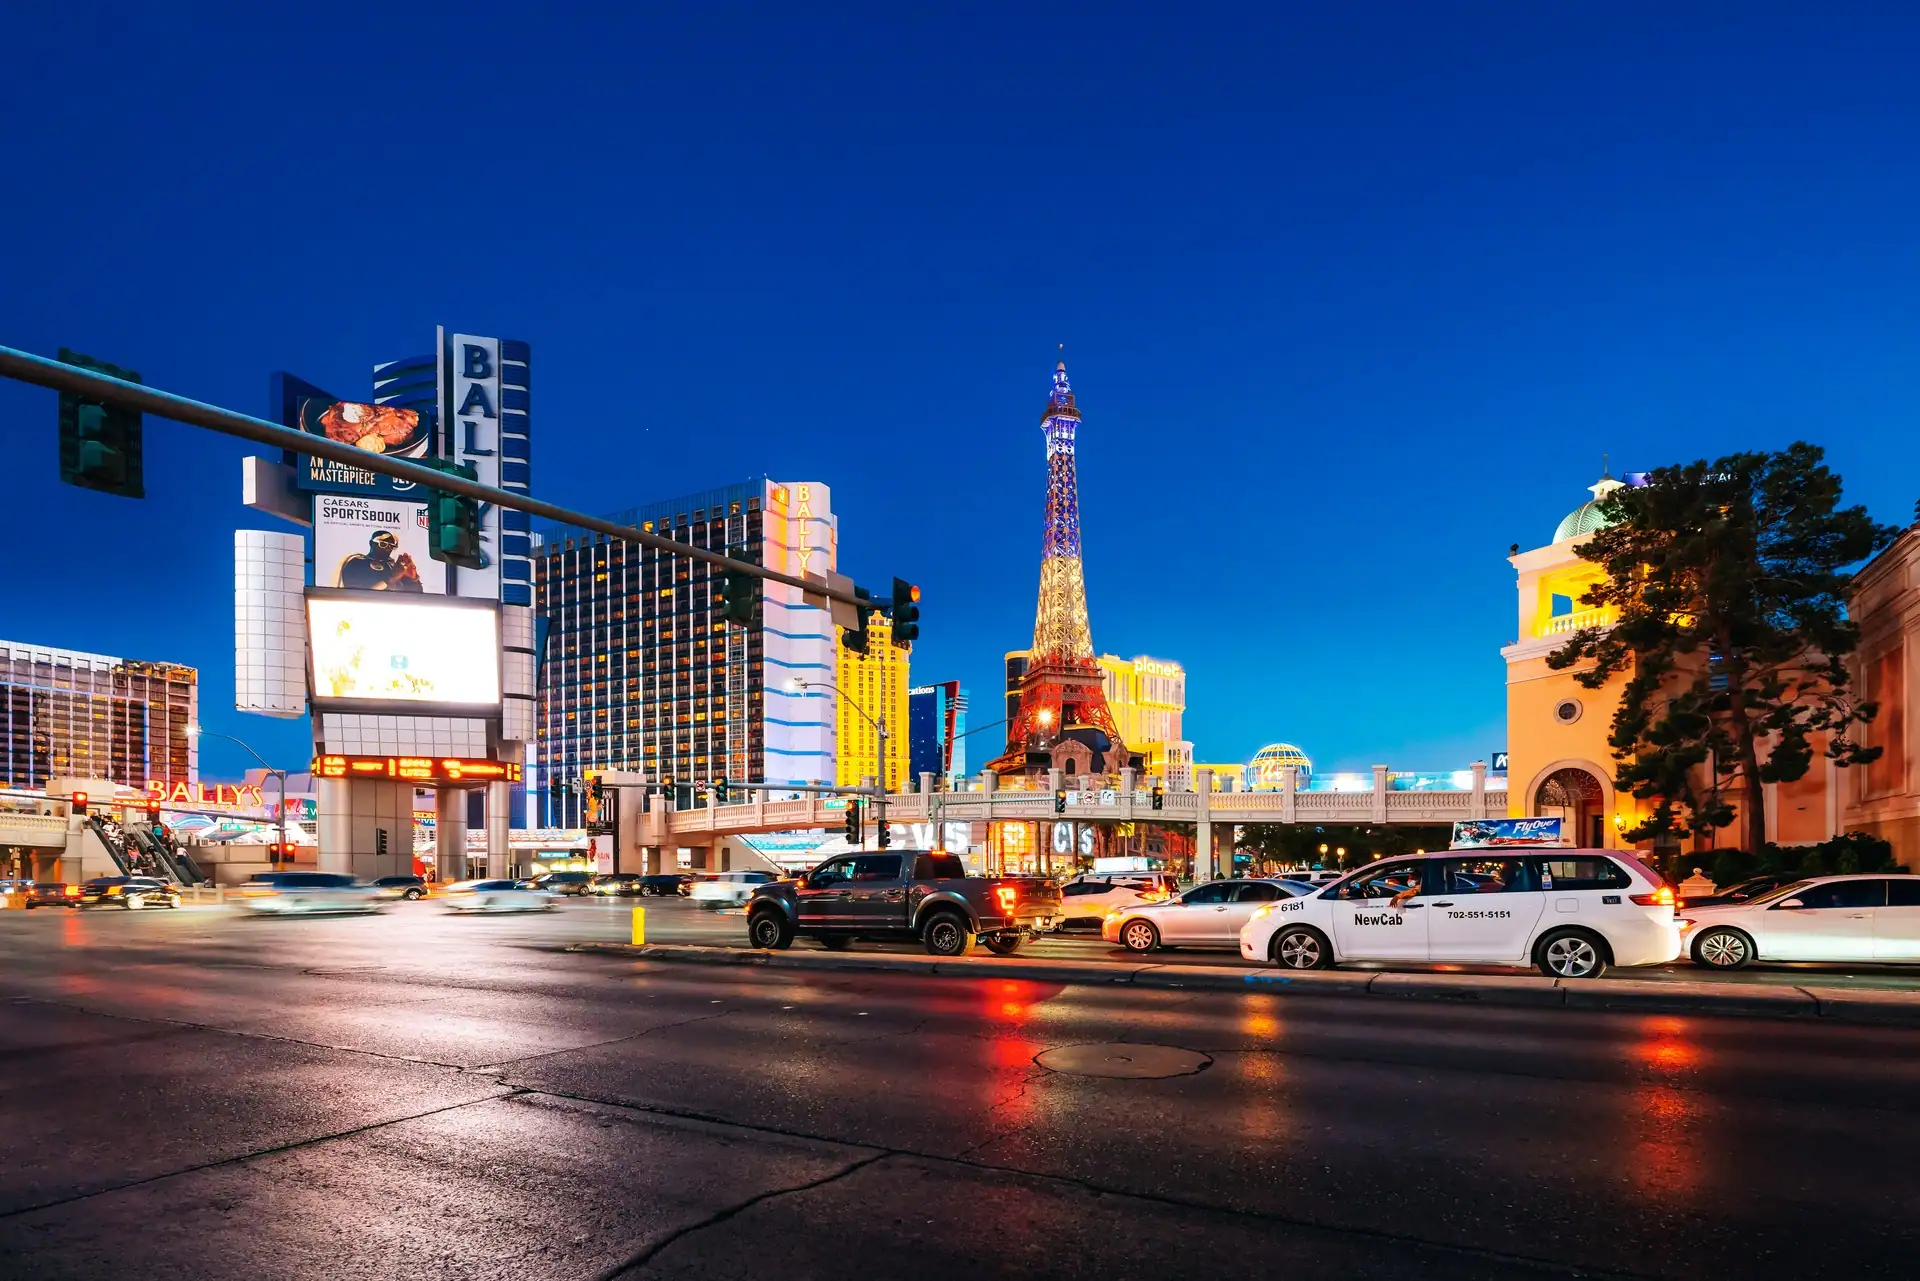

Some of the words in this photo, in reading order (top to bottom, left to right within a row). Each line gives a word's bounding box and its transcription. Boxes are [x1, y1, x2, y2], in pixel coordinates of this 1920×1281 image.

[310, 456, 324, 467] AN
[311, 467, 376, 486] MASTERPIECE
[323, 498, 369, 508] CAESARS
[323, 507, 401, 523] SPORTSBOOK
[1134, 655, 1179, 678] planet
[149, 780, 264, 809] BALLY'S
[1513, 820, 1556, 835] FlyOver
[882, 823, 968, 851] CVS
[1281, 901, 1304, 912] 6181
[1354, 913, 1403, 925] NewCab
[1447, 911, 1511, 919] 702-551-5151
